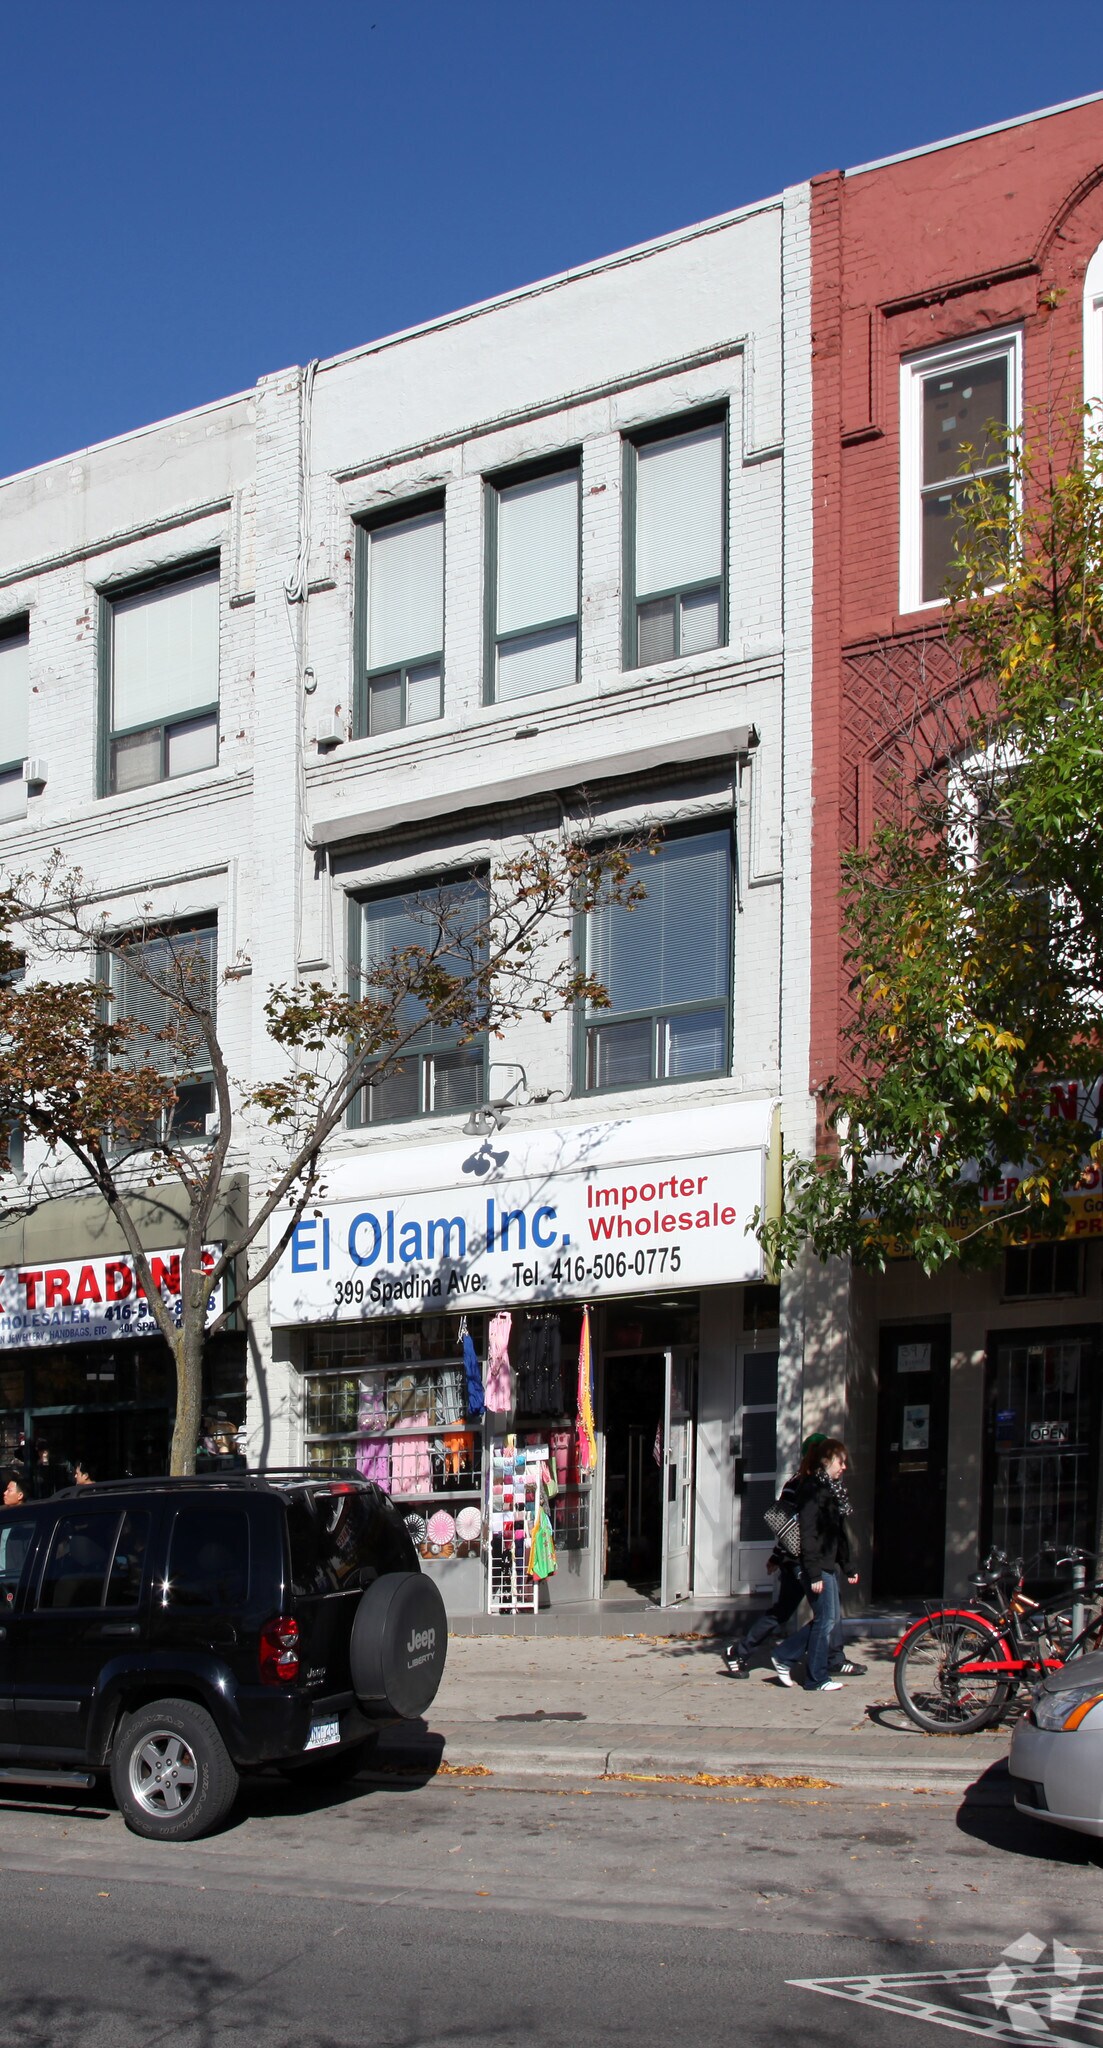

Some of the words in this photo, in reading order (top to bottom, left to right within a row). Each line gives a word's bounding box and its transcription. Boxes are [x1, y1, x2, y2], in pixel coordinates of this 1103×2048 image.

[587, 1175, 708, 1210] Importer
[291, 1217, 330, 1274] El
[348, 1209, 467, 1268] Olam
[486, 1198, 571, 1254] Inc.
[588, 1201, 737, 1241] Wholesale
[512, 1260, 546, 1288] Tel.
[551, 1246, 682, 1284] 416-506-0775
[334, 1280, 364, 1305] 399
[369, 1274, 442, 1308] Spadina
[447, 1269, 487, 1295] Ave.
[93, 1325, 108, 1336] ETC
[1031, 1427, 1069, 1441] OPEN
[406, 1627, 436, 1653] Jeep
[407, 1651, 436, 1670] LIBERTY
